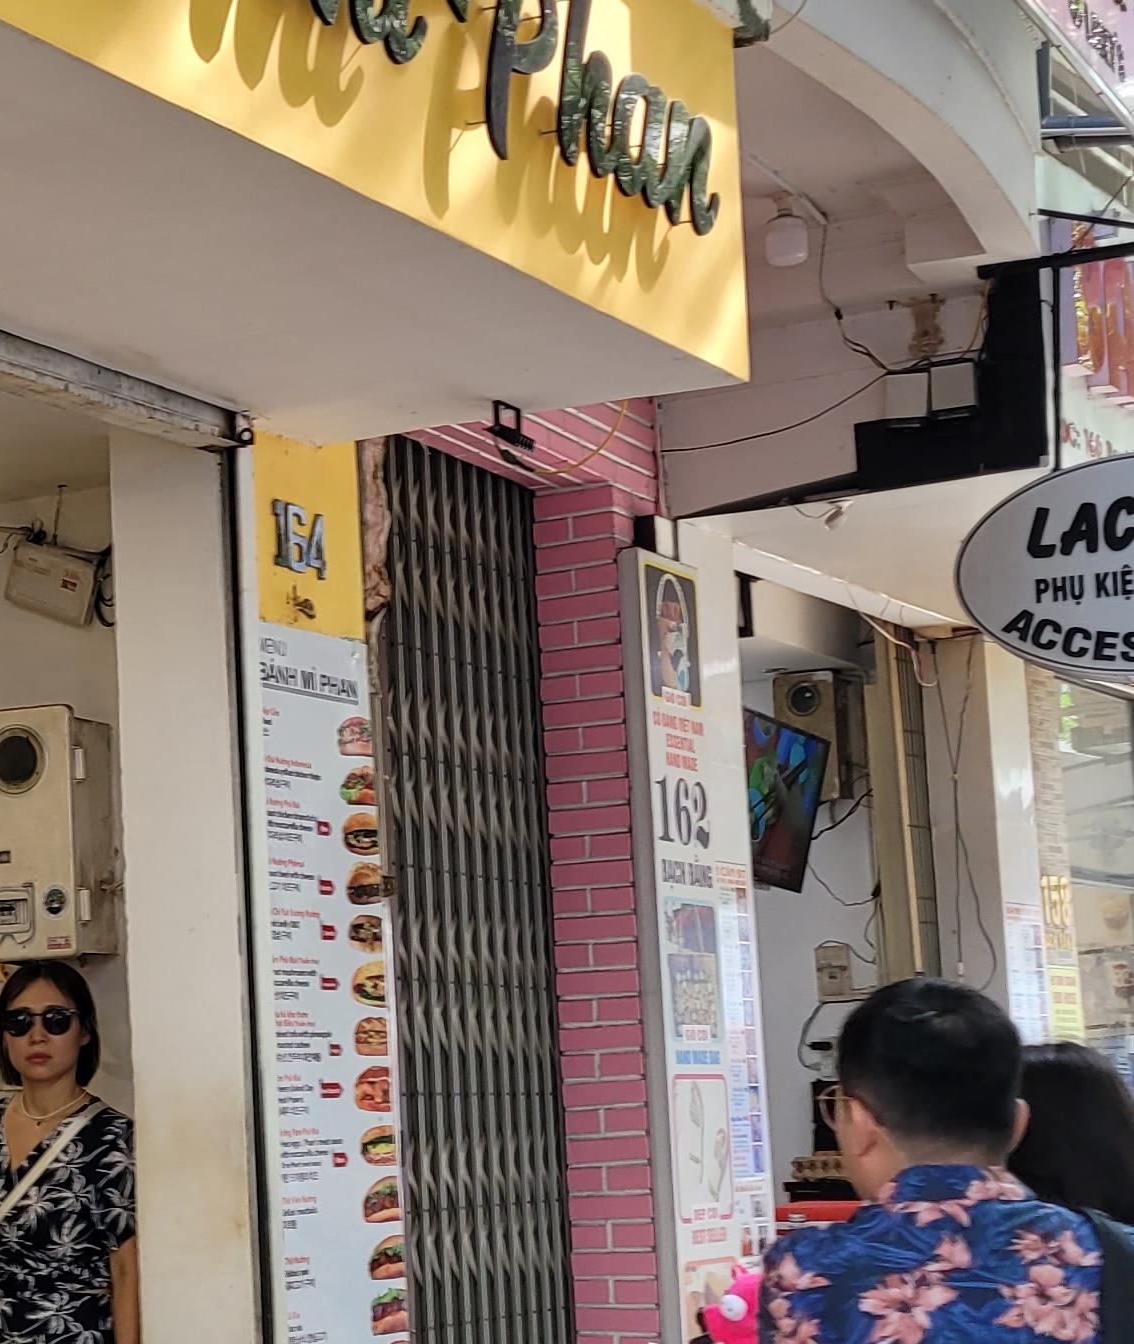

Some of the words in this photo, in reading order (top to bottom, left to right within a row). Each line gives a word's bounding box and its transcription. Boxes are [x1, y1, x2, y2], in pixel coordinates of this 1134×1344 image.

[271, 499, 326, 580] 164
[1027, 496, 1134, 558] LAC
[1035, 574, 1083, 605] PHỤ
[1096, 565, 1133, 600] KIỆ
[320, 674, 358, 698] PHAN
[654, 774, 710, 849] 162
